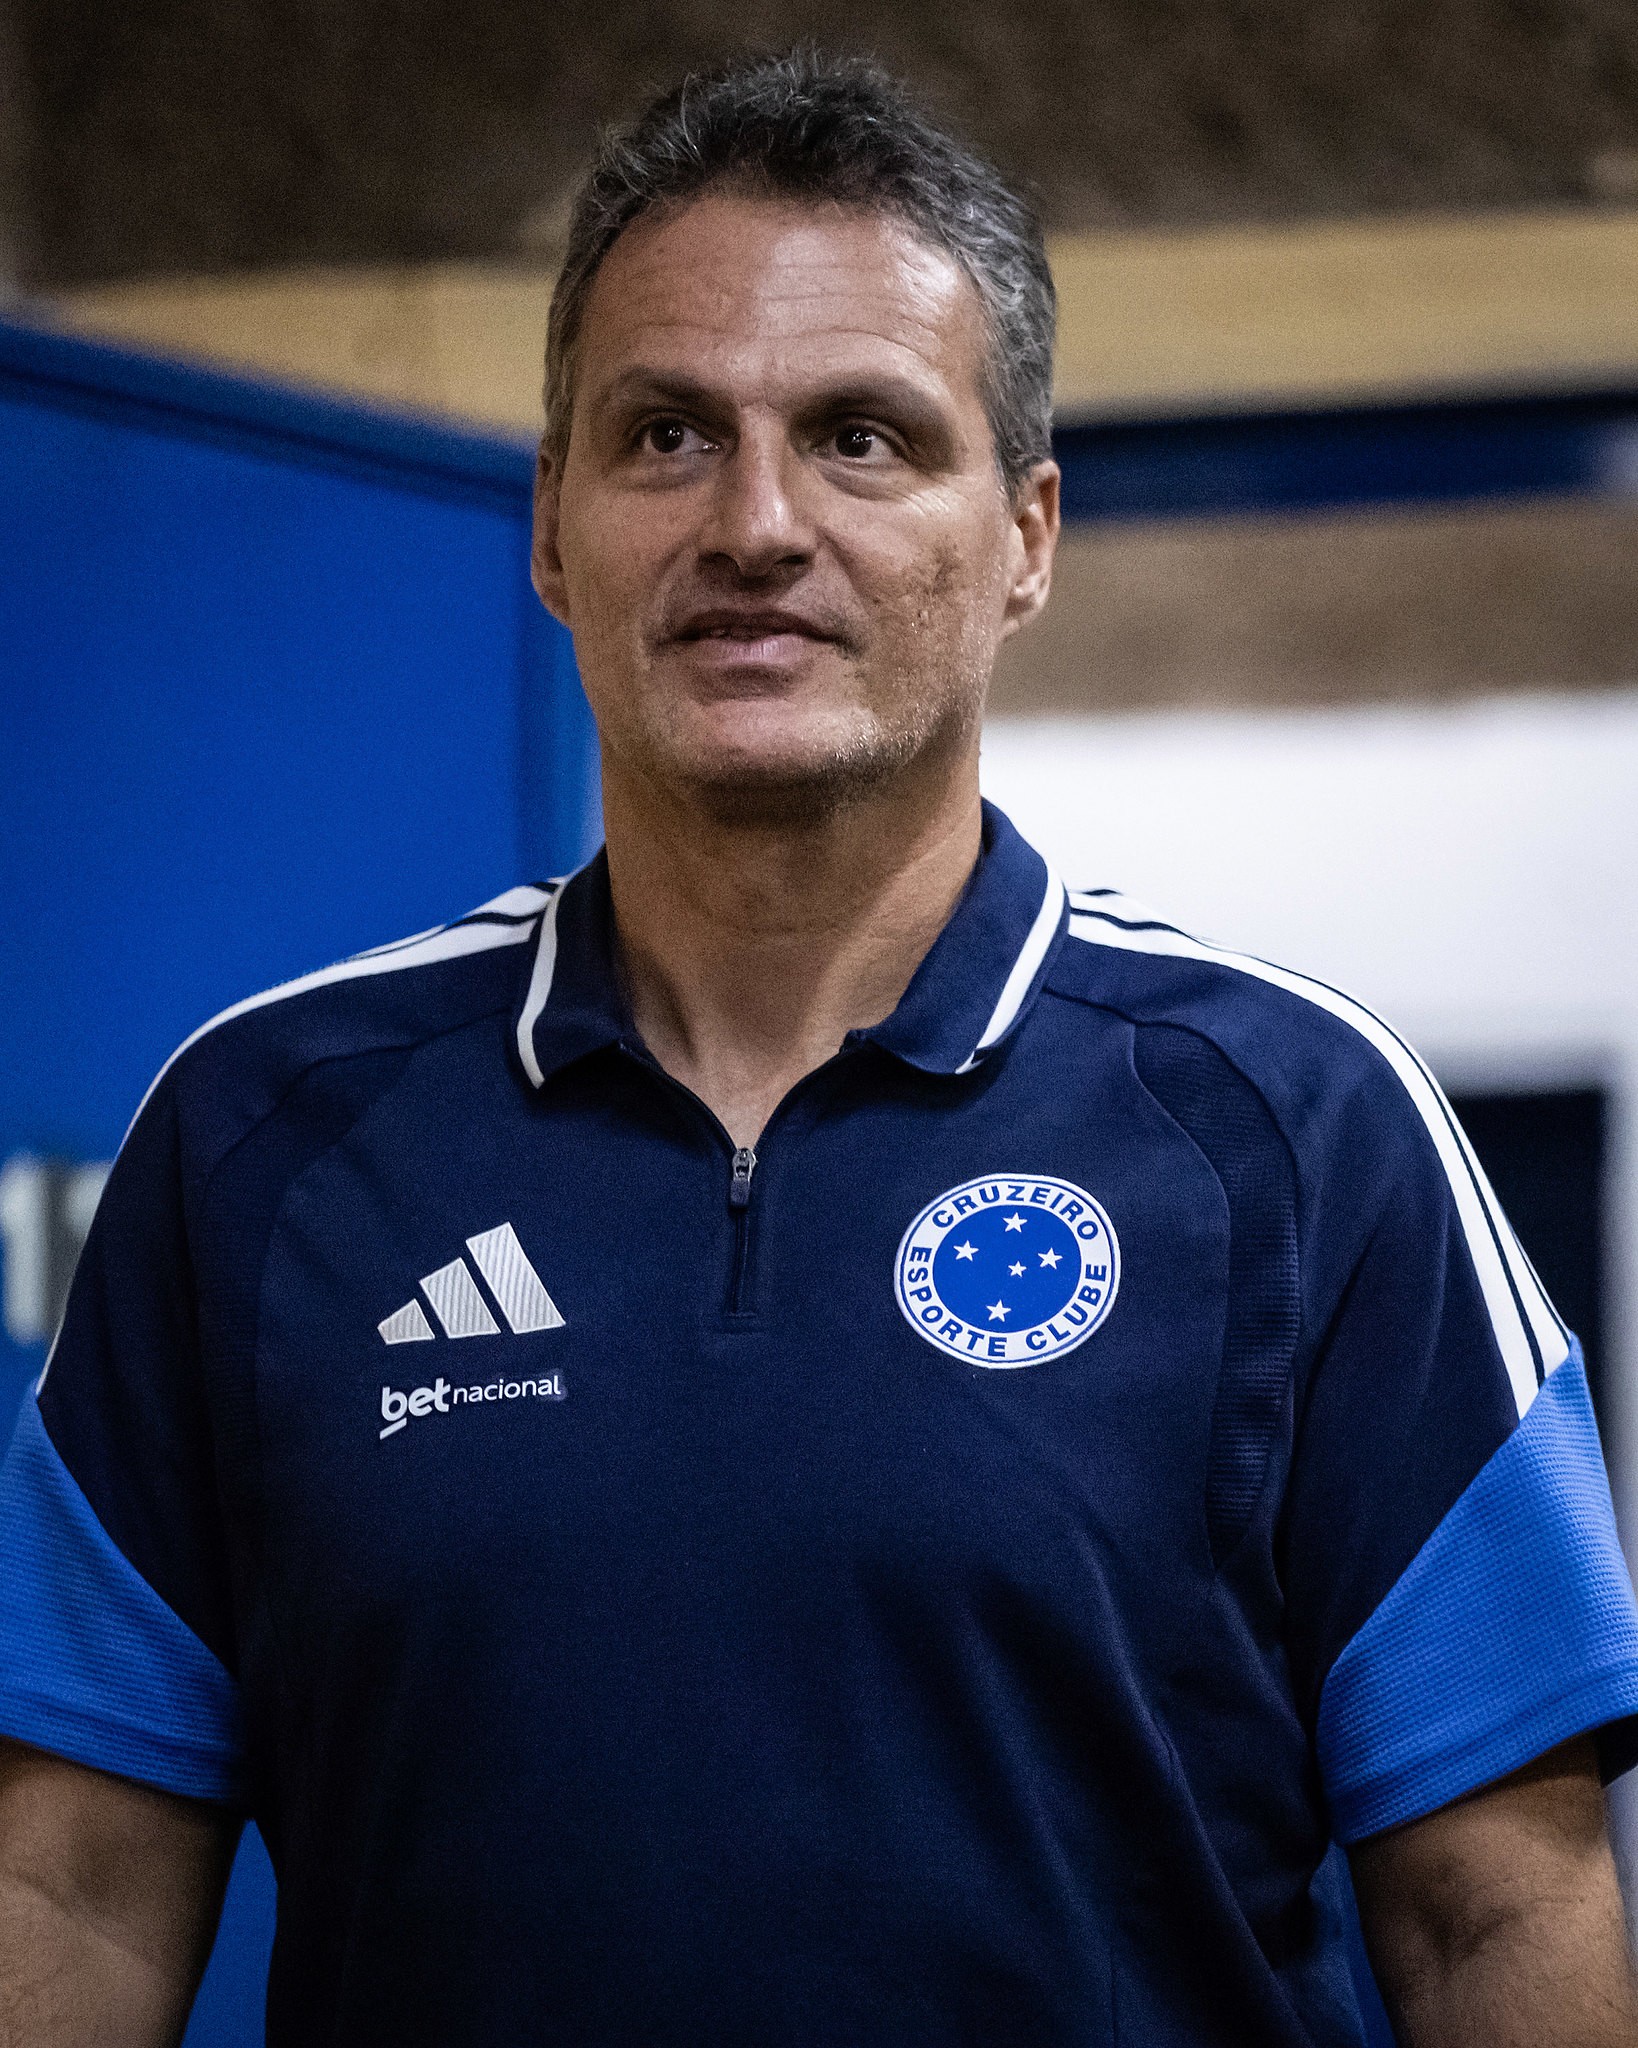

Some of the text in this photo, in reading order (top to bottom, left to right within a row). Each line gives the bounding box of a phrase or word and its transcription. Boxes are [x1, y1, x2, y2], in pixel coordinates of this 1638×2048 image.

[932, 1184, 1099, 1240] CRUZEIRO
[907, 1246, 1107, 1358] ESPORTE CLUBE
